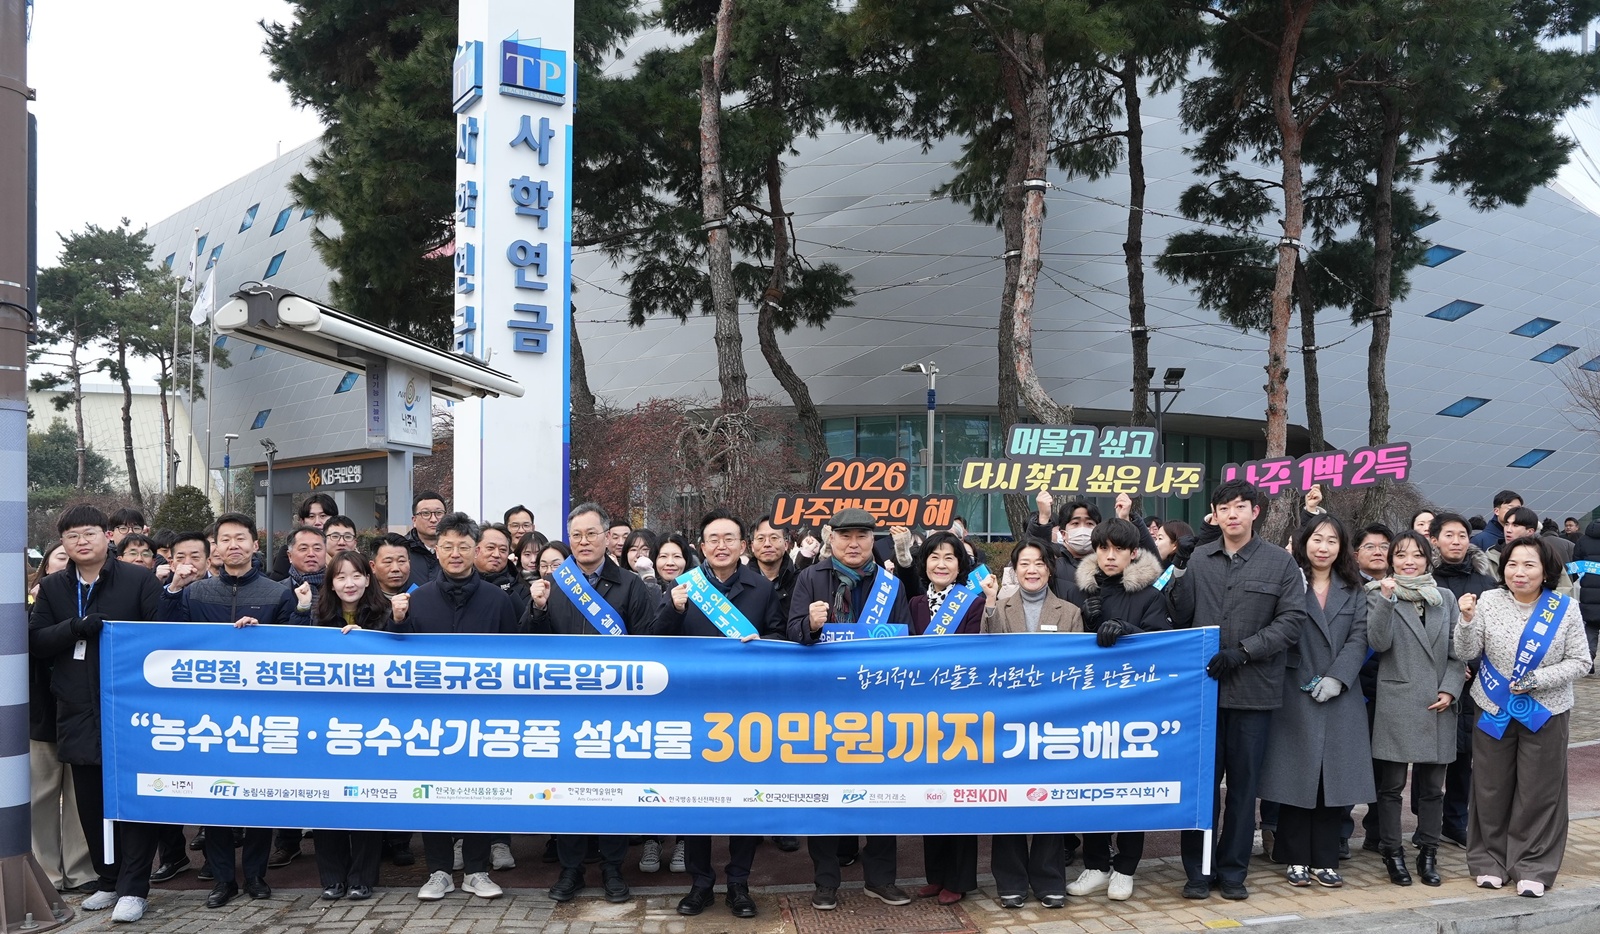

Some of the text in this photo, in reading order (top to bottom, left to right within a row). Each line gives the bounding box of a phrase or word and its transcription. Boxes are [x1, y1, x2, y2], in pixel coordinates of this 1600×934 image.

[506, 53, 561, 91] TP
[507, 114, 555, 354] 사학연금
[401, 413, 418, 429] 나주시
[1010, 428, 1155, 458] 머물고 싶고
[321, 465, 362, 486] KB국민은행
[820, 461, 907, 491] 2026
[962, 462, 1201, 495] 다시 찾고 싶은 나주
[1298, 453, 1348, 491] 1박
[1351, 446, 1408, 485] 2득
[922, 498, 954, 527] 해
[171, 658, 645, 692] 설명절, 청탁금지법 선물규정 바로알기!
[857, 664, 925, 690] 합리적인
[929, 666, 982, 691] 선물로
[988, 665, 1044, 689] 청렴한
[1051, 663, 1096, 691] 나주를
[1102, 663, 1160, 689] 만들어요
[326, 717, 561, 759] 농수산가공품
[573, 719, 693, 760] 설선물
[701, 711, 996, 764] 30만원까지
[1002, 720, 1181, 761] 가능해요”
[172, 781, 194, 790] 나주시
[243, 787, 330, 799] 농림식품기술기획평가원
[361, 787, 398, 799] 사학연금
[412, 784, 513, 799] aT 한국농수산식품유통공사
[568, 787, 623, 796] 한국문화예술위원회
[953, 788, 1008, 803] 한전KDN
[638, 795, 660, 803] KCA
[765, 793, 829, 803] 한국인터넷진흥원
[842, 792, 907, 801] KPX 전력거래소
